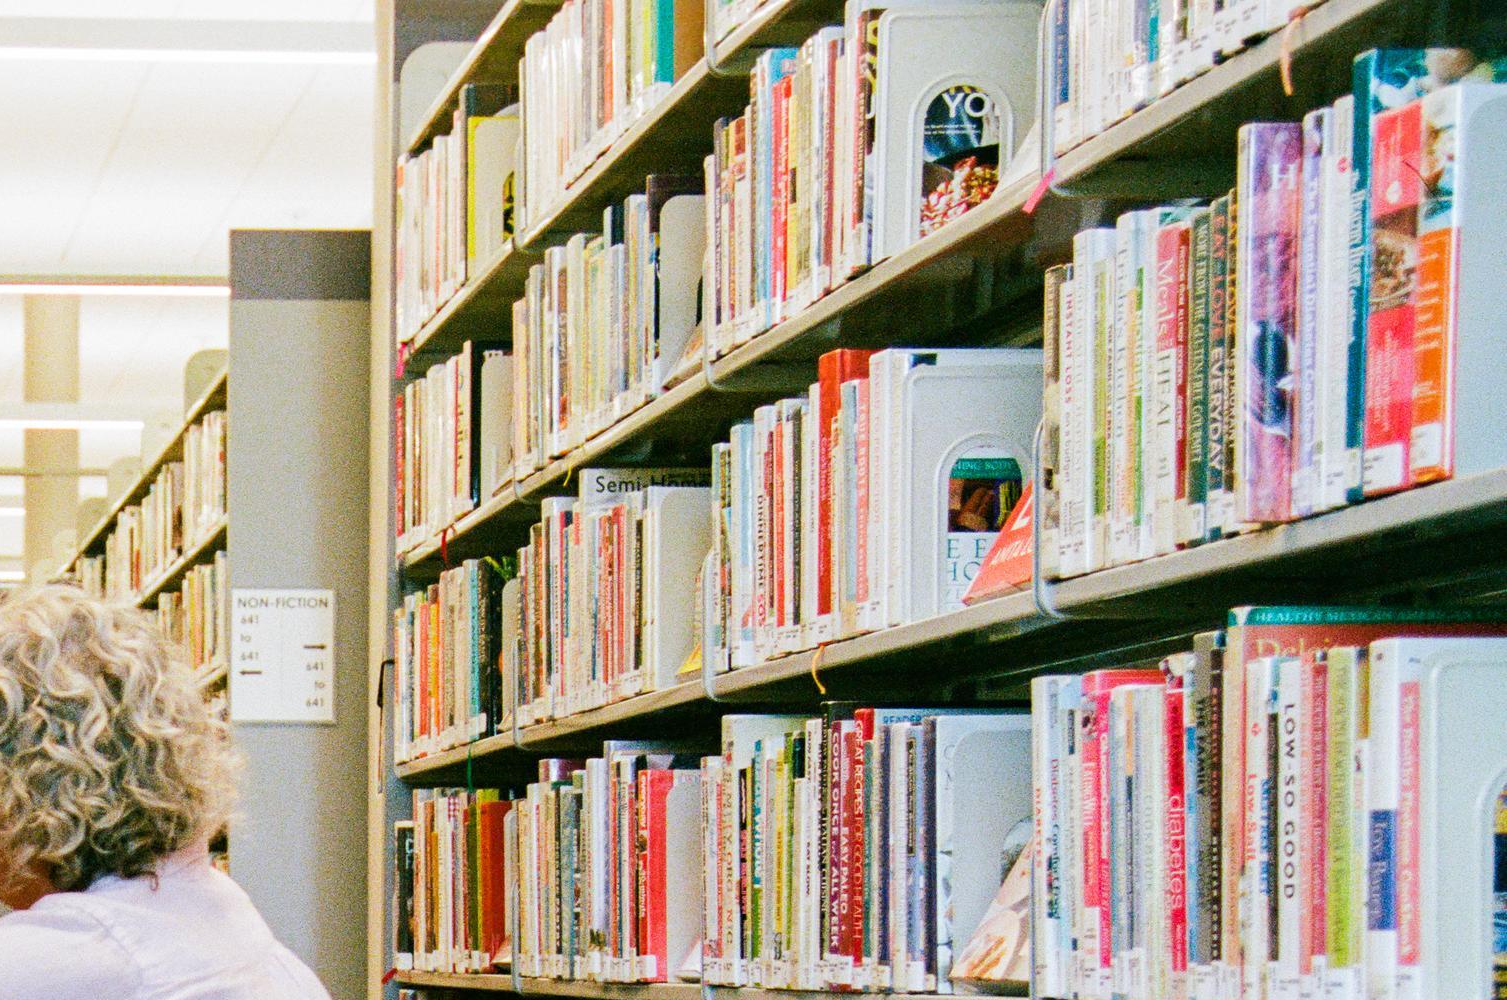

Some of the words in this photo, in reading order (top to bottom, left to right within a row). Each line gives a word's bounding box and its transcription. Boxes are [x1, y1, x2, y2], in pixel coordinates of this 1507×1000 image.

[942, 93, 992, 118] YO
[1157, 259, 1174, 336] Meals
[1065, 293, 1073, 359] INSTANT
[1065, 366, 1073, 404] LOSS
[1210, 347, 1223, 470] EVERYDAY
[757, 494, 765, 589] DINNERTIME
[237, 597, 329, 609] NON-FICTION
[241, 615, 259, 625] 641
[240, 634, 251, 643] to
[241, 651, 259, 661] 641
[306, 662, 325, 671] 641
[315, 681, 325, 690] to
[306, 698, 325, 707] 641
[831, 732, 840, 784] COOK
[1284, 703, 1295, 809] LOW-SO
[831, 788, 840, 835] ONCE
[853, 764, 863, 815] RECIPES
[1051, 758, 1060, 822] Diabetes
[1245, 773, 1257, 861] Low-Salt
[840, 826, 849, 862] EASY
[1168, 795, 1184, 911] diabetes
[1284, 821, 1296, 900] GOOD
[831, 866, 840, 896] ALL
[840, 866, 849, 914] PALEO
[831, 899, 840, 947] WEEK
